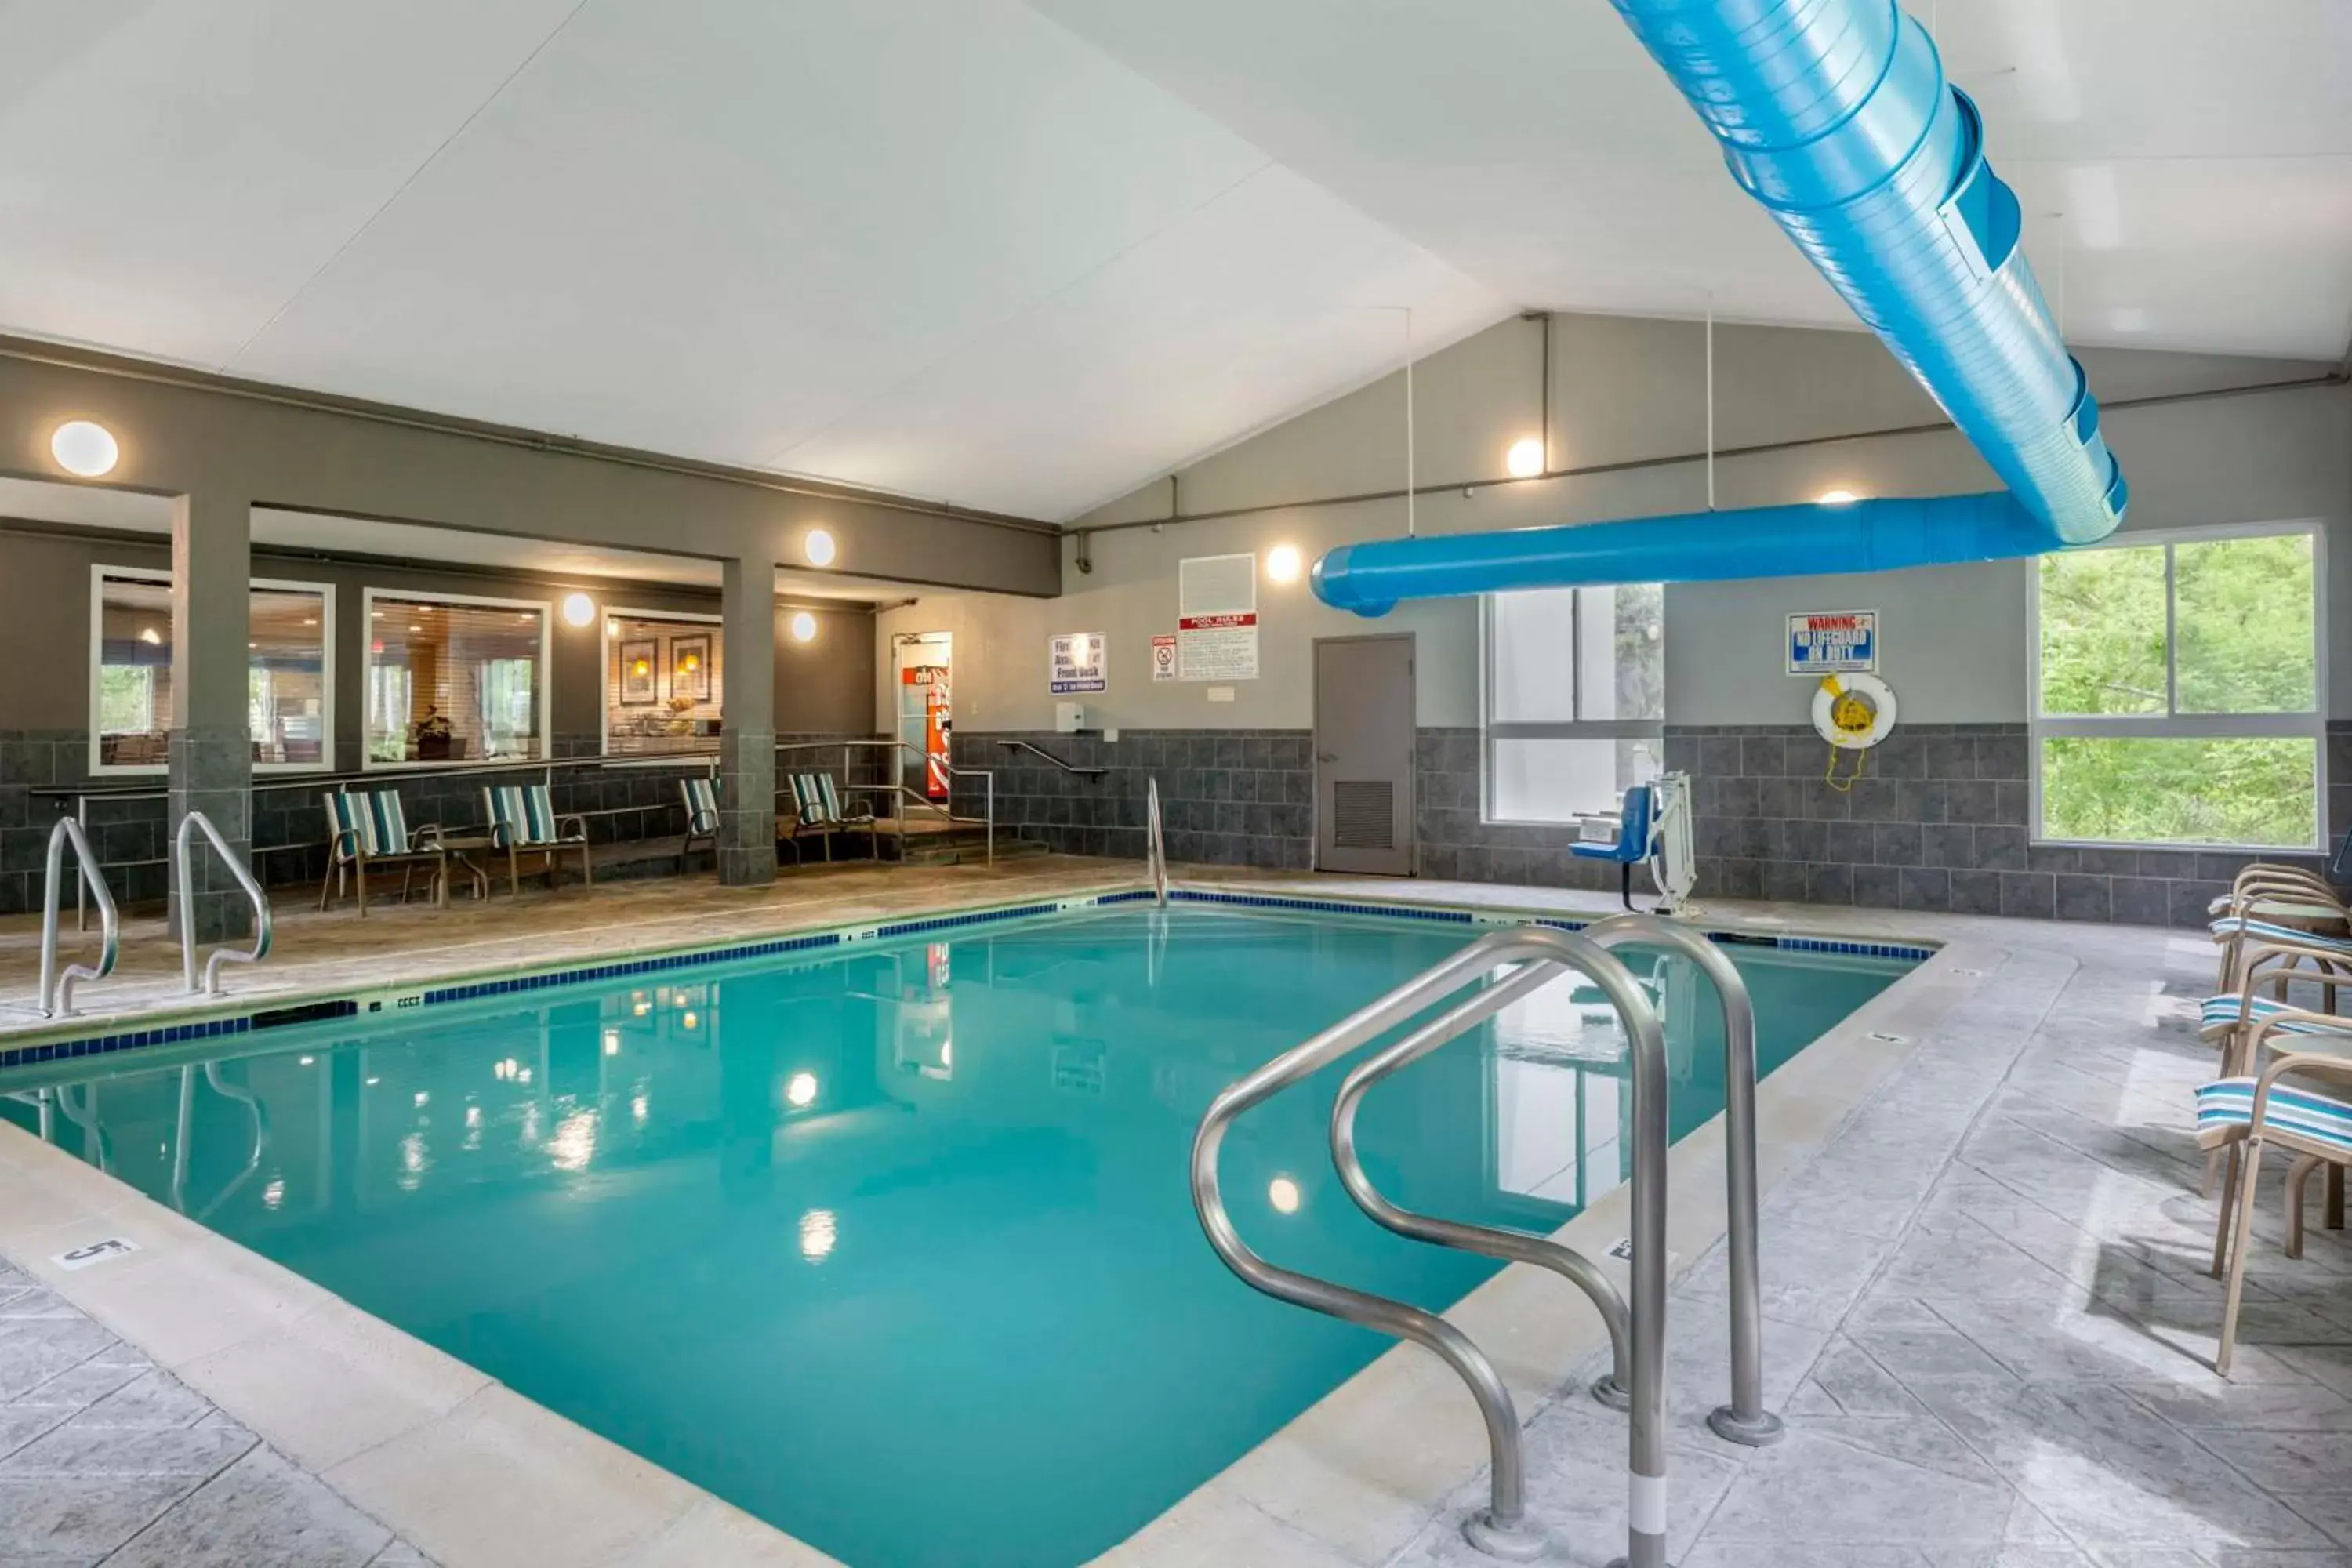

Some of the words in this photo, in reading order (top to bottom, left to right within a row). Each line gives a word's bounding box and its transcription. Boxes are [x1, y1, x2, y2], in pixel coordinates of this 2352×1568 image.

[1808, 615, 1856, 630] WARNING
[1797, 631, 1810, 646] NO
[1813, 630, 1867, 645] LIFEGUARD
[1808, 646, 1823, 662] ON
[1827, 645, 1854, 661] DUTY
